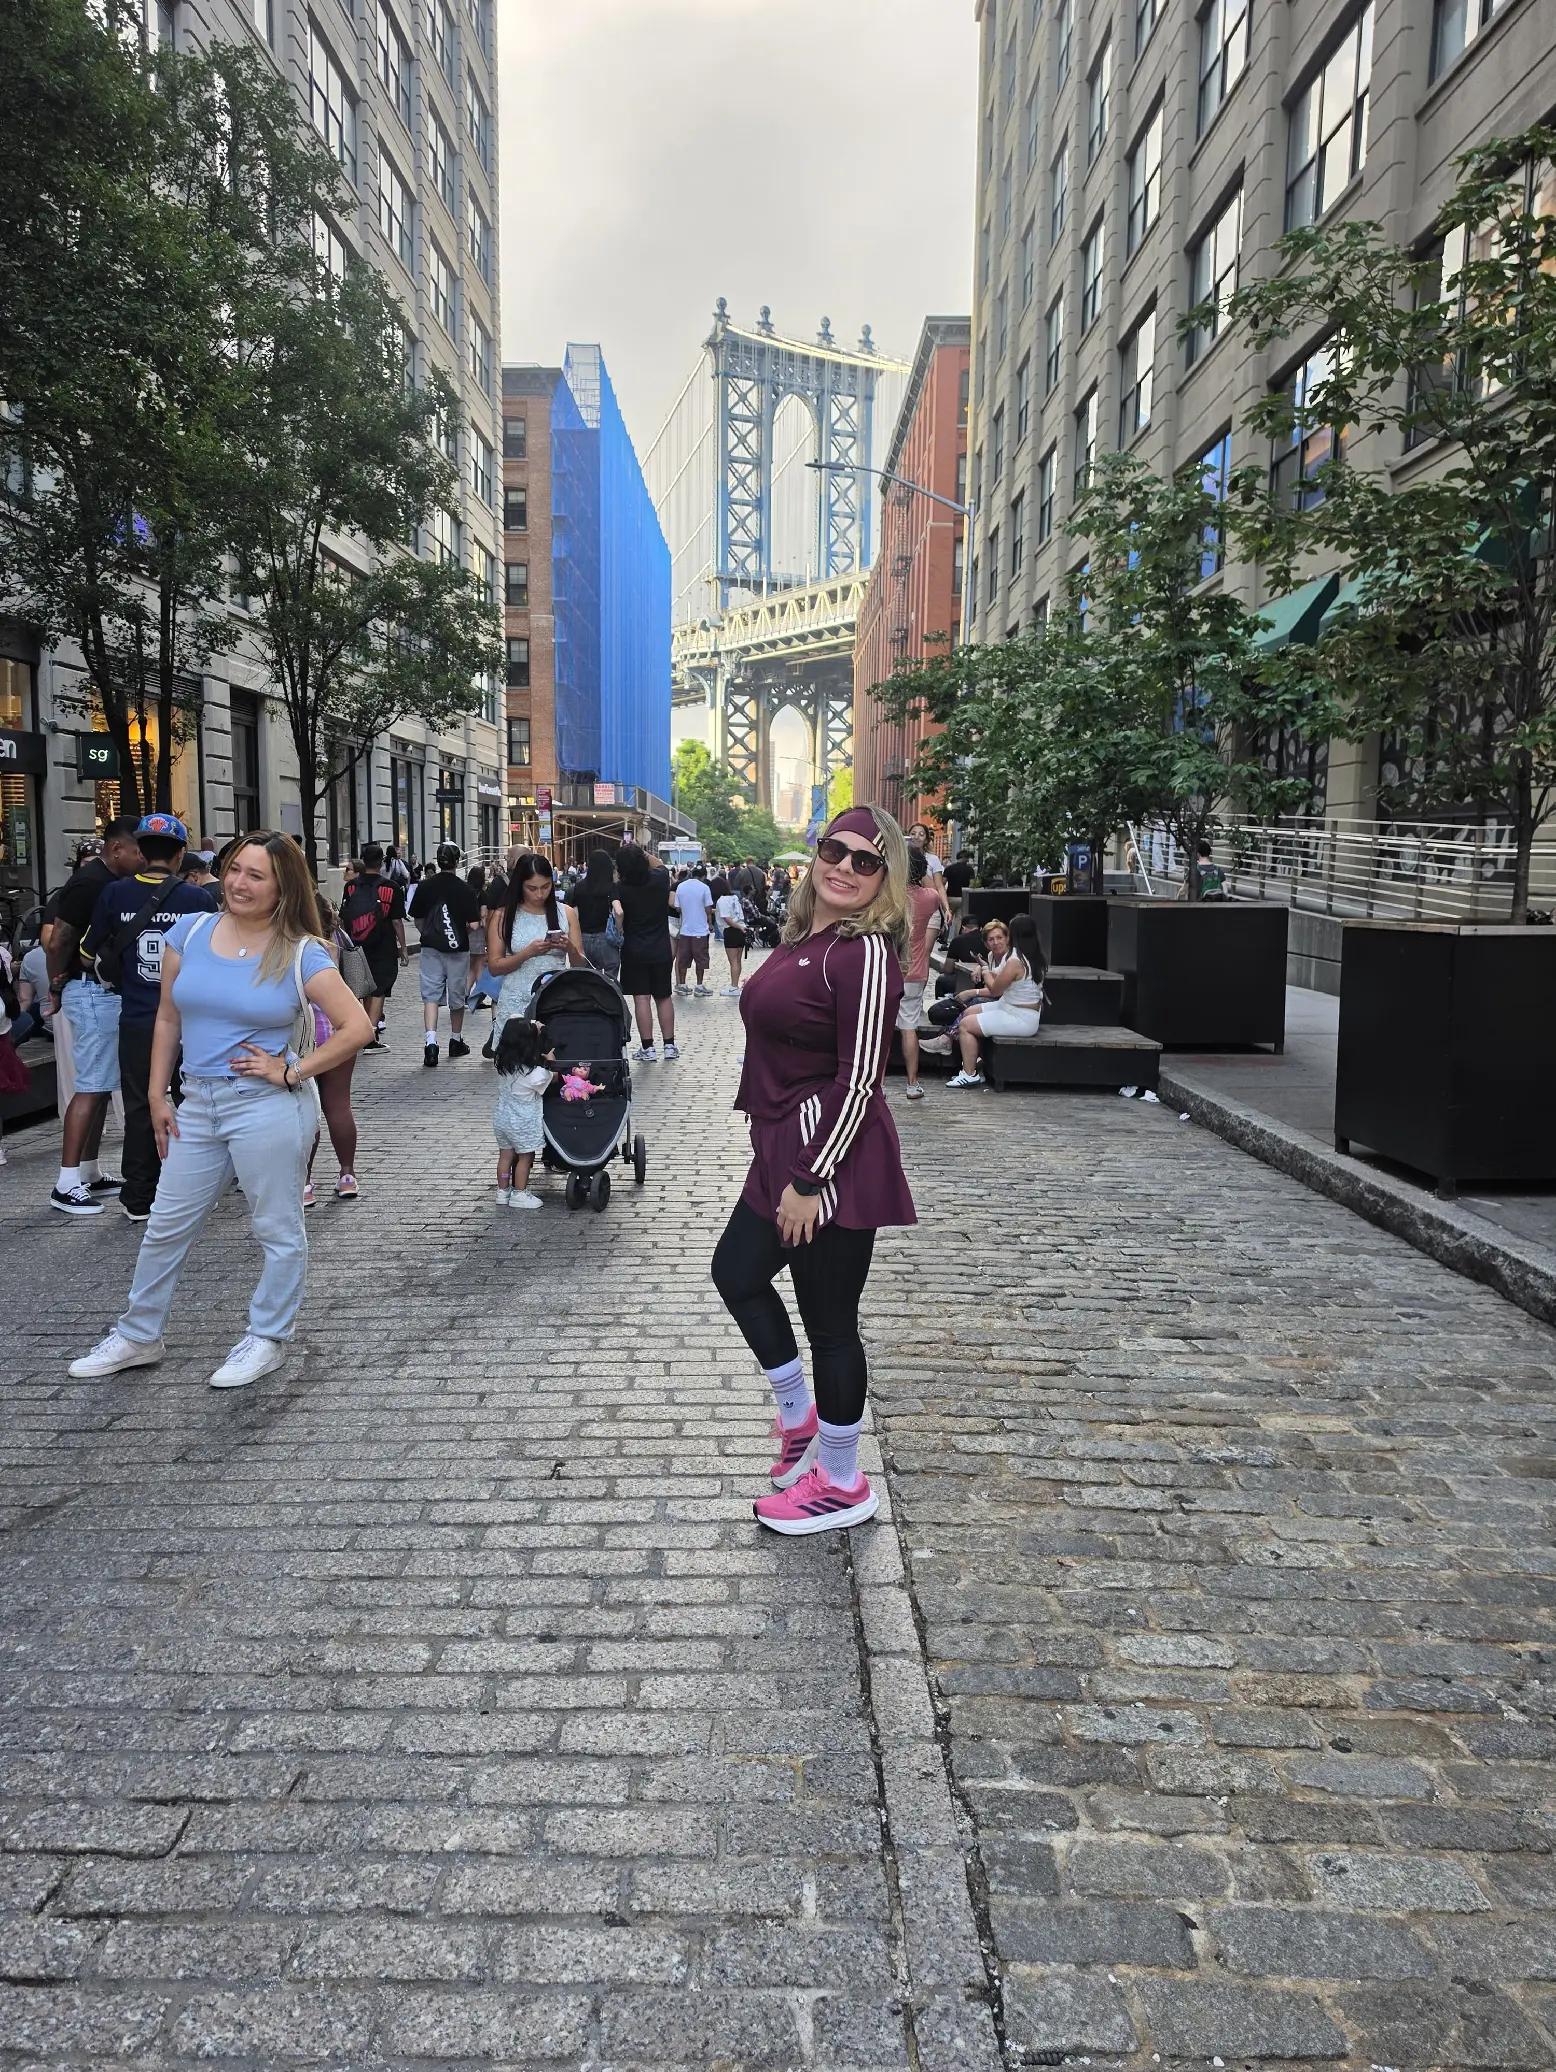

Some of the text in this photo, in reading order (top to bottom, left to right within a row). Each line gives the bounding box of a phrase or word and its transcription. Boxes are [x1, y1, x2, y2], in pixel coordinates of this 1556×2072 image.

[88, 748, 109, 762] sg
[1078, 855, 1088, 869] P
[441, 903, 459, 949] adidas
[136, 929, 167, 983] 9
